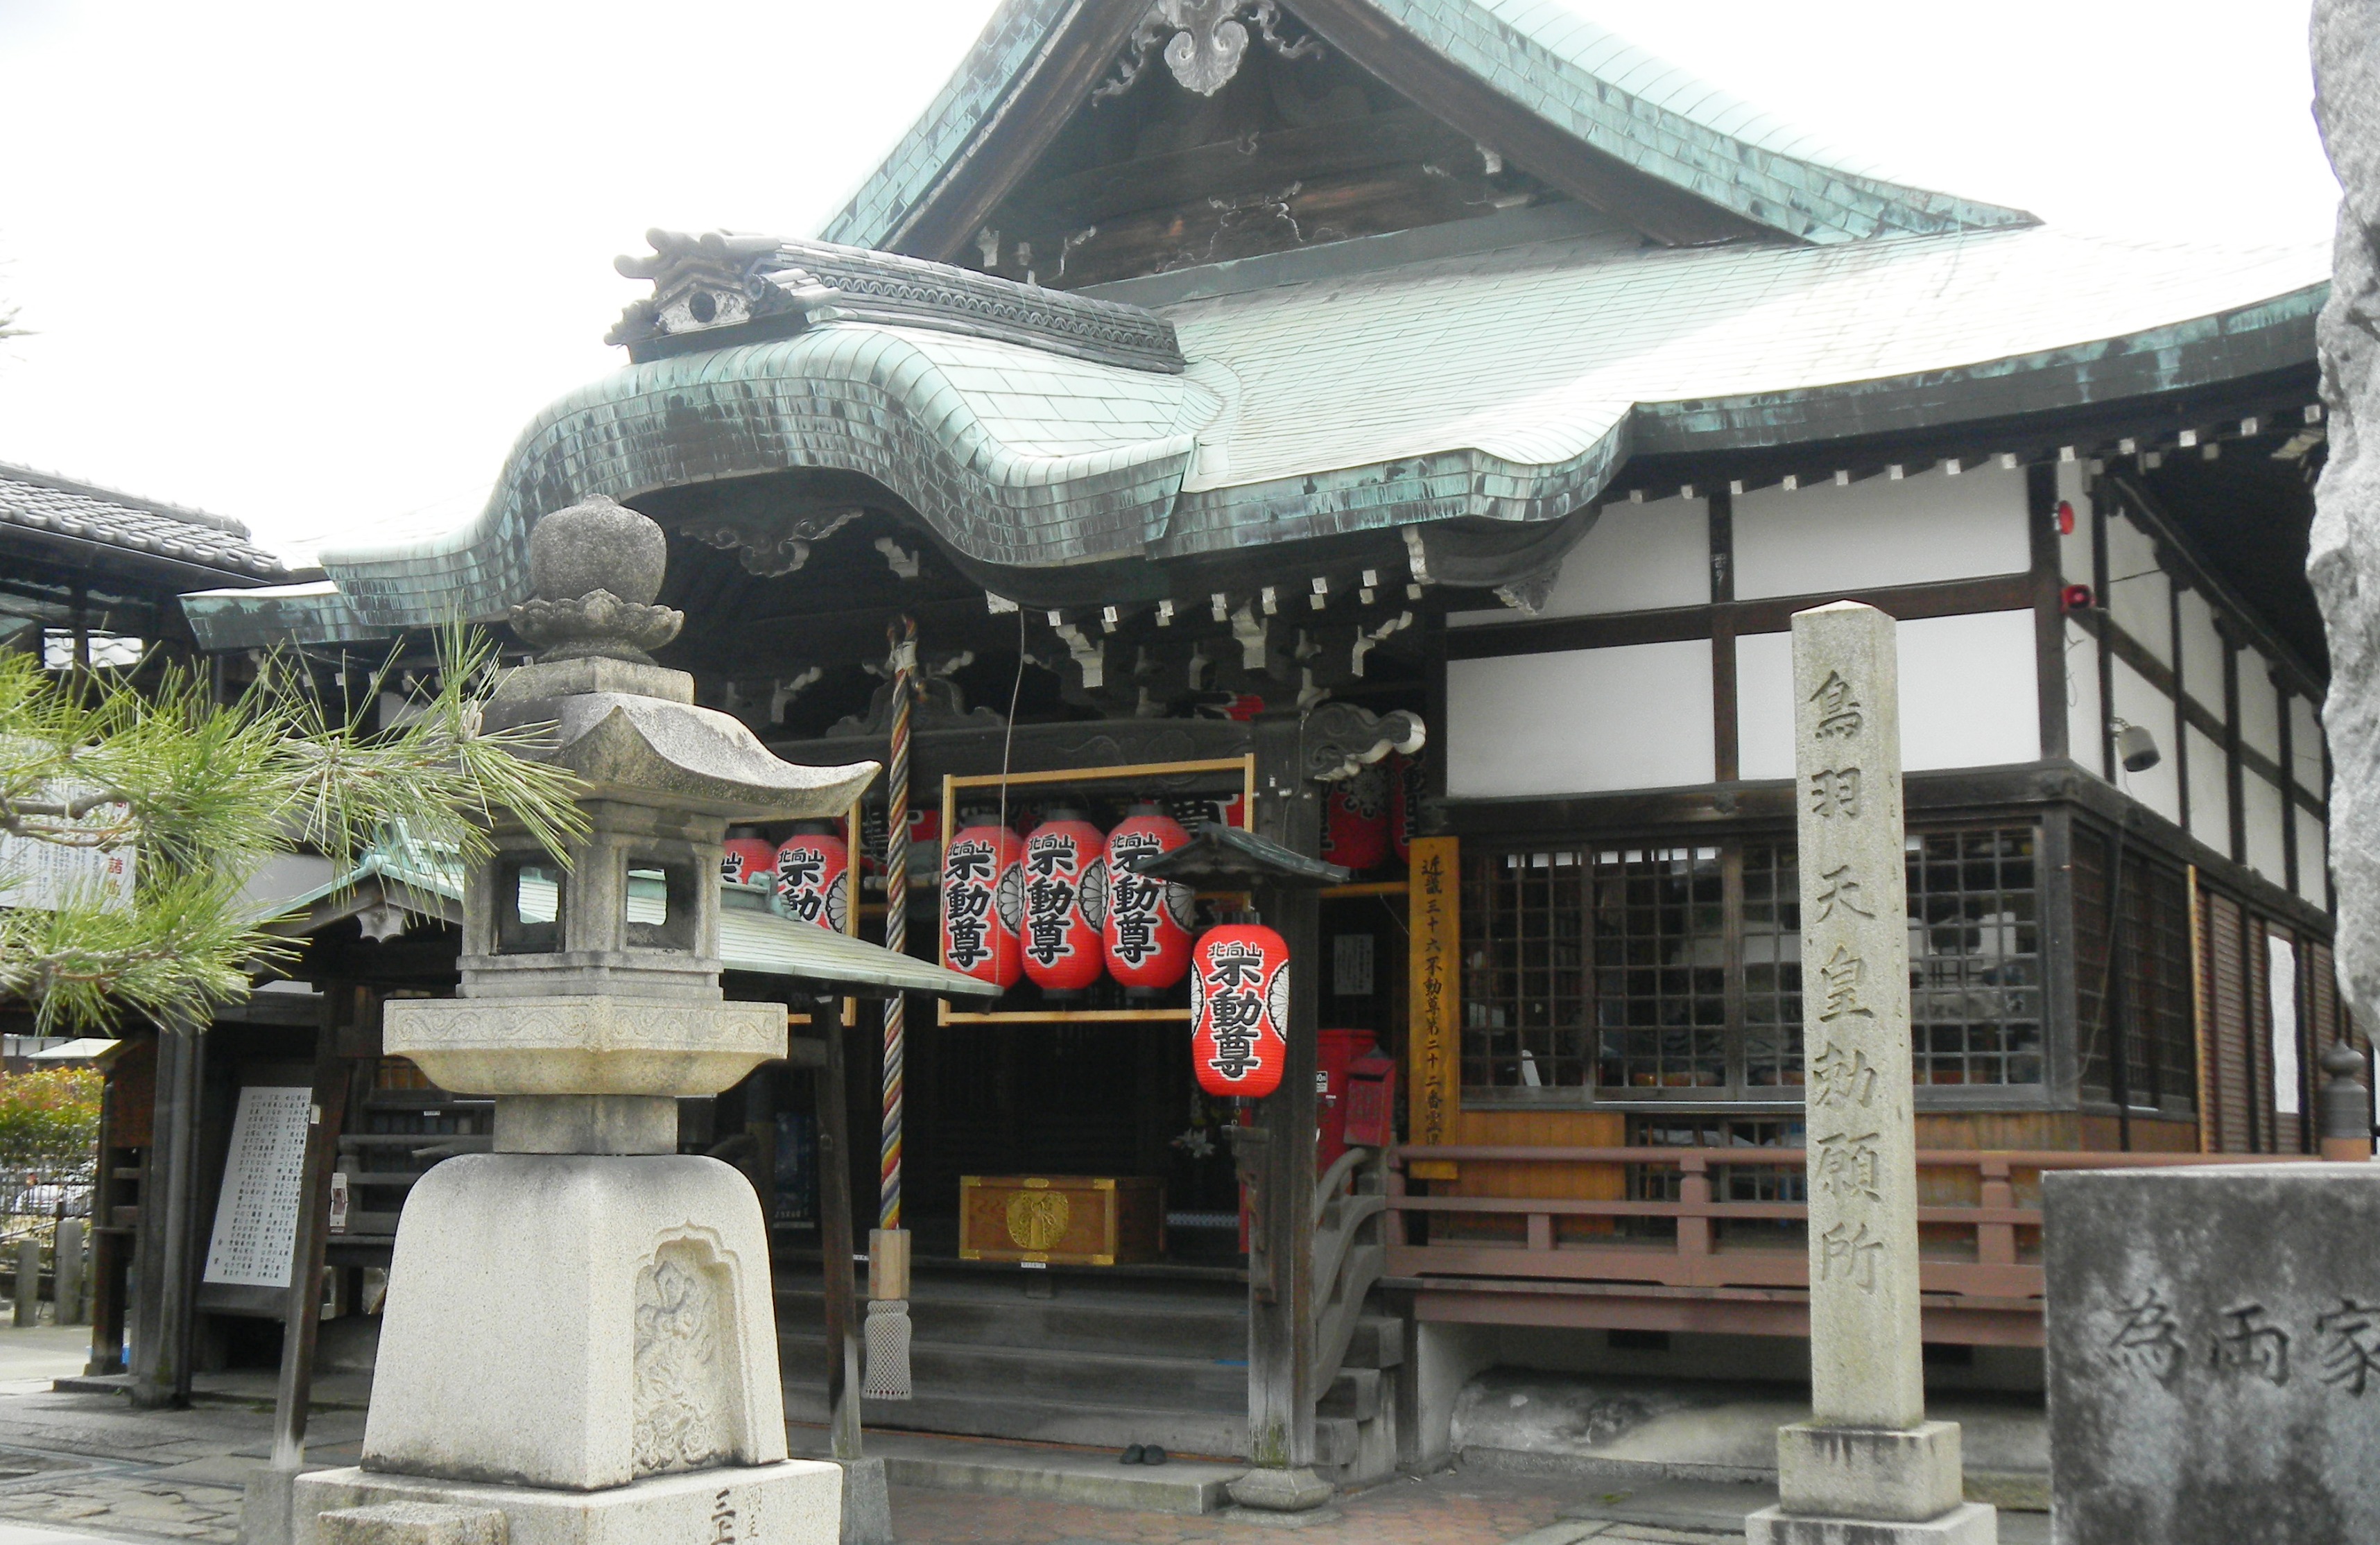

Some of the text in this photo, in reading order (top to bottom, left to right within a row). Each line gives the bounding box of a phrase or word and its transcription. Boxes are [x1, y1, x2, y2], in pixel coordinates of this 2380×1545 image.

[778, 848, 825, 863] 北向山
[949, 841, 994, 856] 北向山
[1029, 835, 1075, 850] 北向山
[1112, 834, 1159, 848] 北向山
[945, 854, 991, 967] 不動尊
[1027, 849, 1074, 964] 不動尊
[1112, 847, 1159, 963] 不動尊
[1207, 942, 1262, 957] 北向山
[1809, 670, 1883, 1295] 鳥羽天皇勅願所
[1208, 958, 1262, 1078] 不動尊
